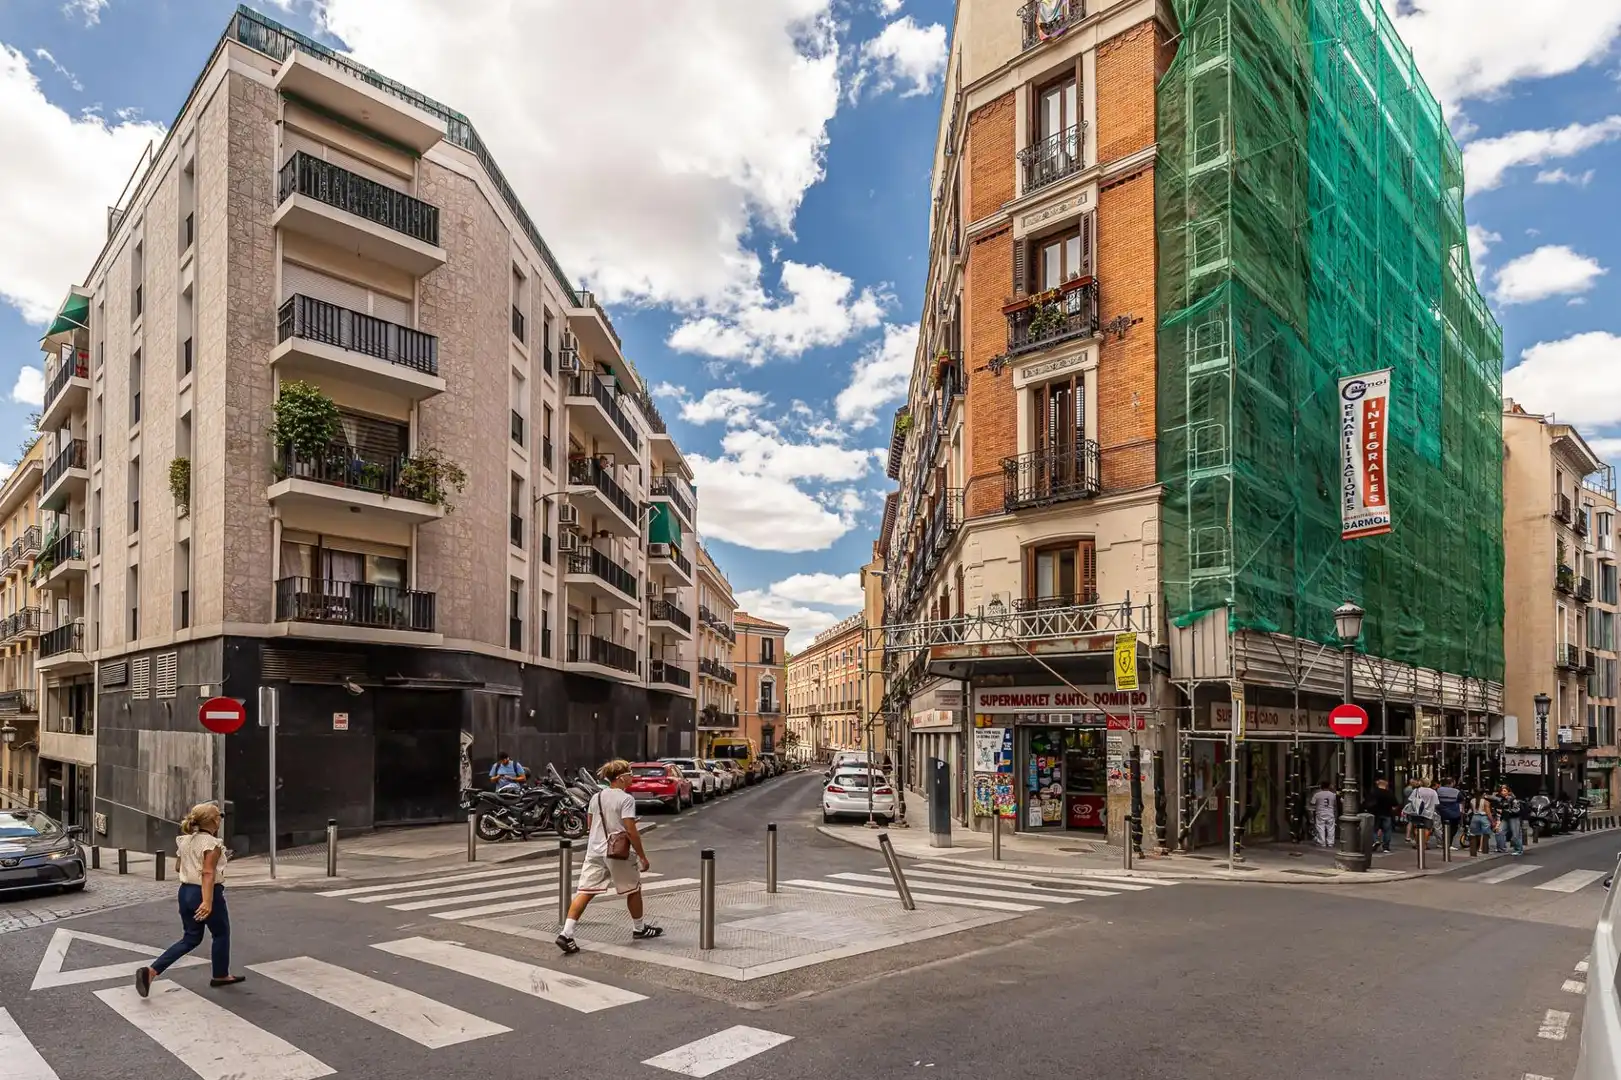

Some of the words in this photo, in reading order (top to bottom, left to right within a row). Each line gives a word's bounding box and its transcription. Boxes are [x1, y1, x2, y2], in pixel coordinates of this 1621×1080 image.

[1343, 403, 1356, 511] REHABILITACIONES
[1366, 400, 1380, 503] INTEGRALES
[1343, 516, 1389, 530] GARMOL
[980, 693, 1050, 706] SUPERMARKET
[1055, 692, 1088, 706] SANTO
[1094, 691, 1147, 706] DOMINGO
[937, 761, 944, 769] P
[1518, 759, 1541, 767] PAC
